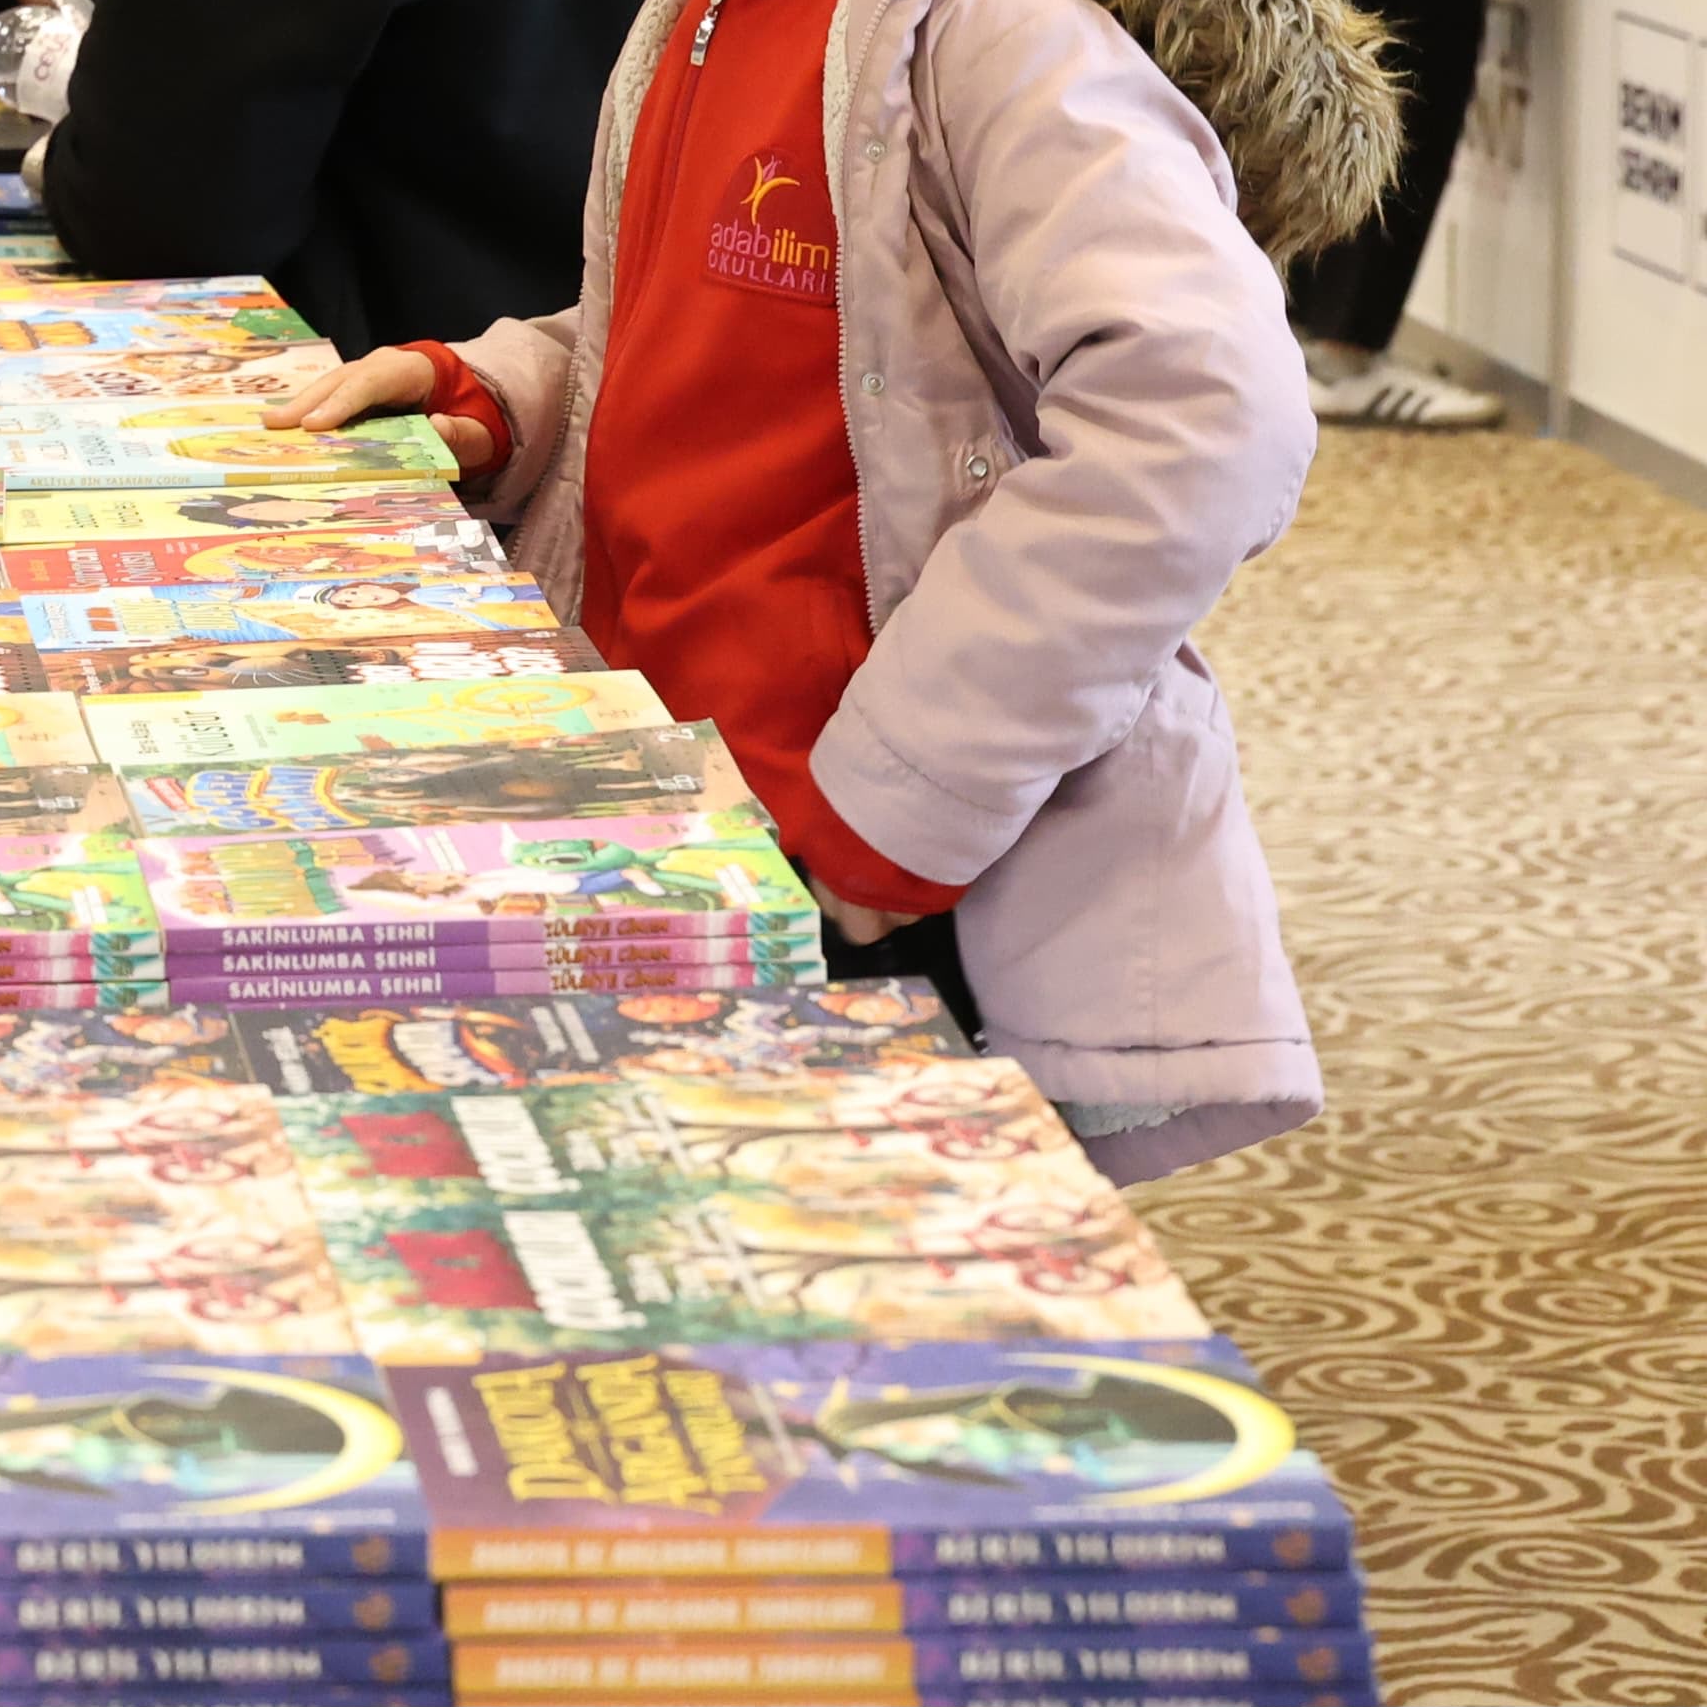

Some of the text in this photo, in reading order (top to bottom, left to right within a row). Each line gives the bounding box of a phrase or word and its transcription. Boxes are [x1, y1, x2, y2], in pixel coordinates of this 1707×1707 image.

[710, 219, 830, 271] adabilim
[707, 249, 827, 294] OKULLARI
[222, 921, 435, 945] SAKİNLUMBA ŞEHRİ
[222, 947, 436, 973] SAKİNLUMBA ŞEHRİ
[228, 972, 442, 999] SAKİNLUMBA ŞEHRİ
